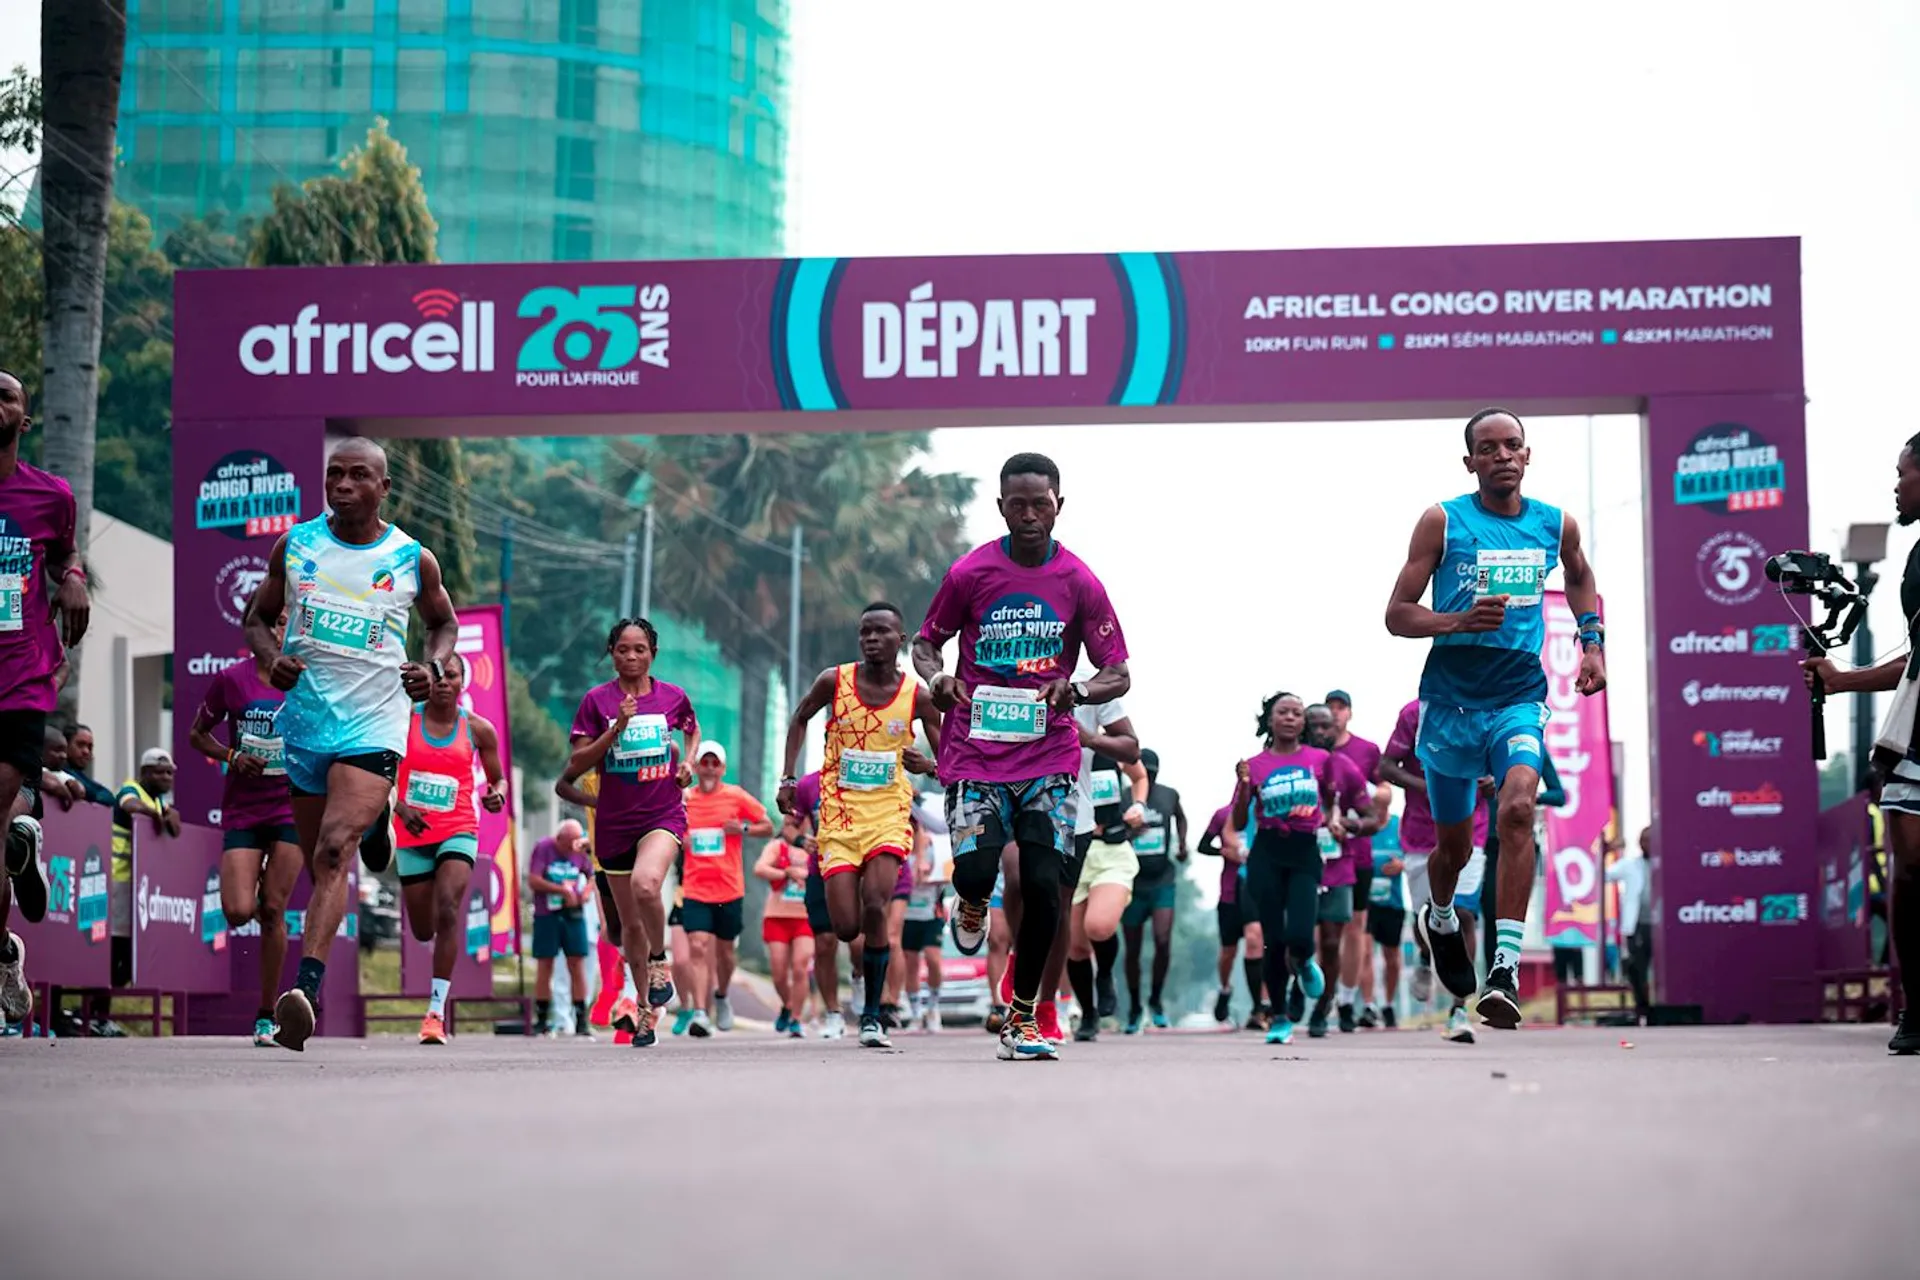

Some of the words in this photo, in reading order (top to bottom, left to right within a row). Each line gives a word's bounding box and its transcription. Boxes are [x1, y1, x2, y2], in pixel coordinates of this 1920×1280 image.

[1244, 294, 1386, 319] AFRICELL
[1390, 291, 1499, 316] CONGO
[1504, 289, 1594, 314] RIVER
[1600, 284, 1772, 312] MARATHON
[516, 285, 641, 371] 25
[639, 284, 670, 368] ANS
[862, 281, 1096, 378] DÉPART
[239, 301, 495, 376] africell
[1245, 337, 1290, 352] 10KM
[1293, 336, 1328, 351] FUN
[1331, 335, 1368, 350] RUN
[1404, 333, 1449, 349] 21KM
[1496, 330, 1594, 347] MARATHON
[1623, 327, 1672, 343] 42KM
[1674, 325, 1773, 343] MARATHON
[516, 372, 560, 386] POUR
[563, 370, 640, 387] L'AFRIQUE
[1694, 431, 1750, 453] africell
[217, 459, 268, 479] africell
[200, 477, 249, 501] CONGO
[252, 472, 295, 494] RIVER
[1681, 468, 1779, 495] MARATHON
[202, 495, 295, 521] MARATHON
[1493, 566, 1534, 584] 4238
[318, 612, 366, 636] 4222
[991, 604, 1042, 621] africell
[979, 621, 1022, 641] CONGO
[1025, 621, 1066, 639] RIVER
[1670, 629, 1748, 654] africell
[980, 640, 1061, 661] MARATHON
[986, 703, 1031, 721] 4294
[1721, 737, 1783, 752] IMPACT
[851, 762, 885, 776] 4224
[1678, 899, 1757, 923] africell
